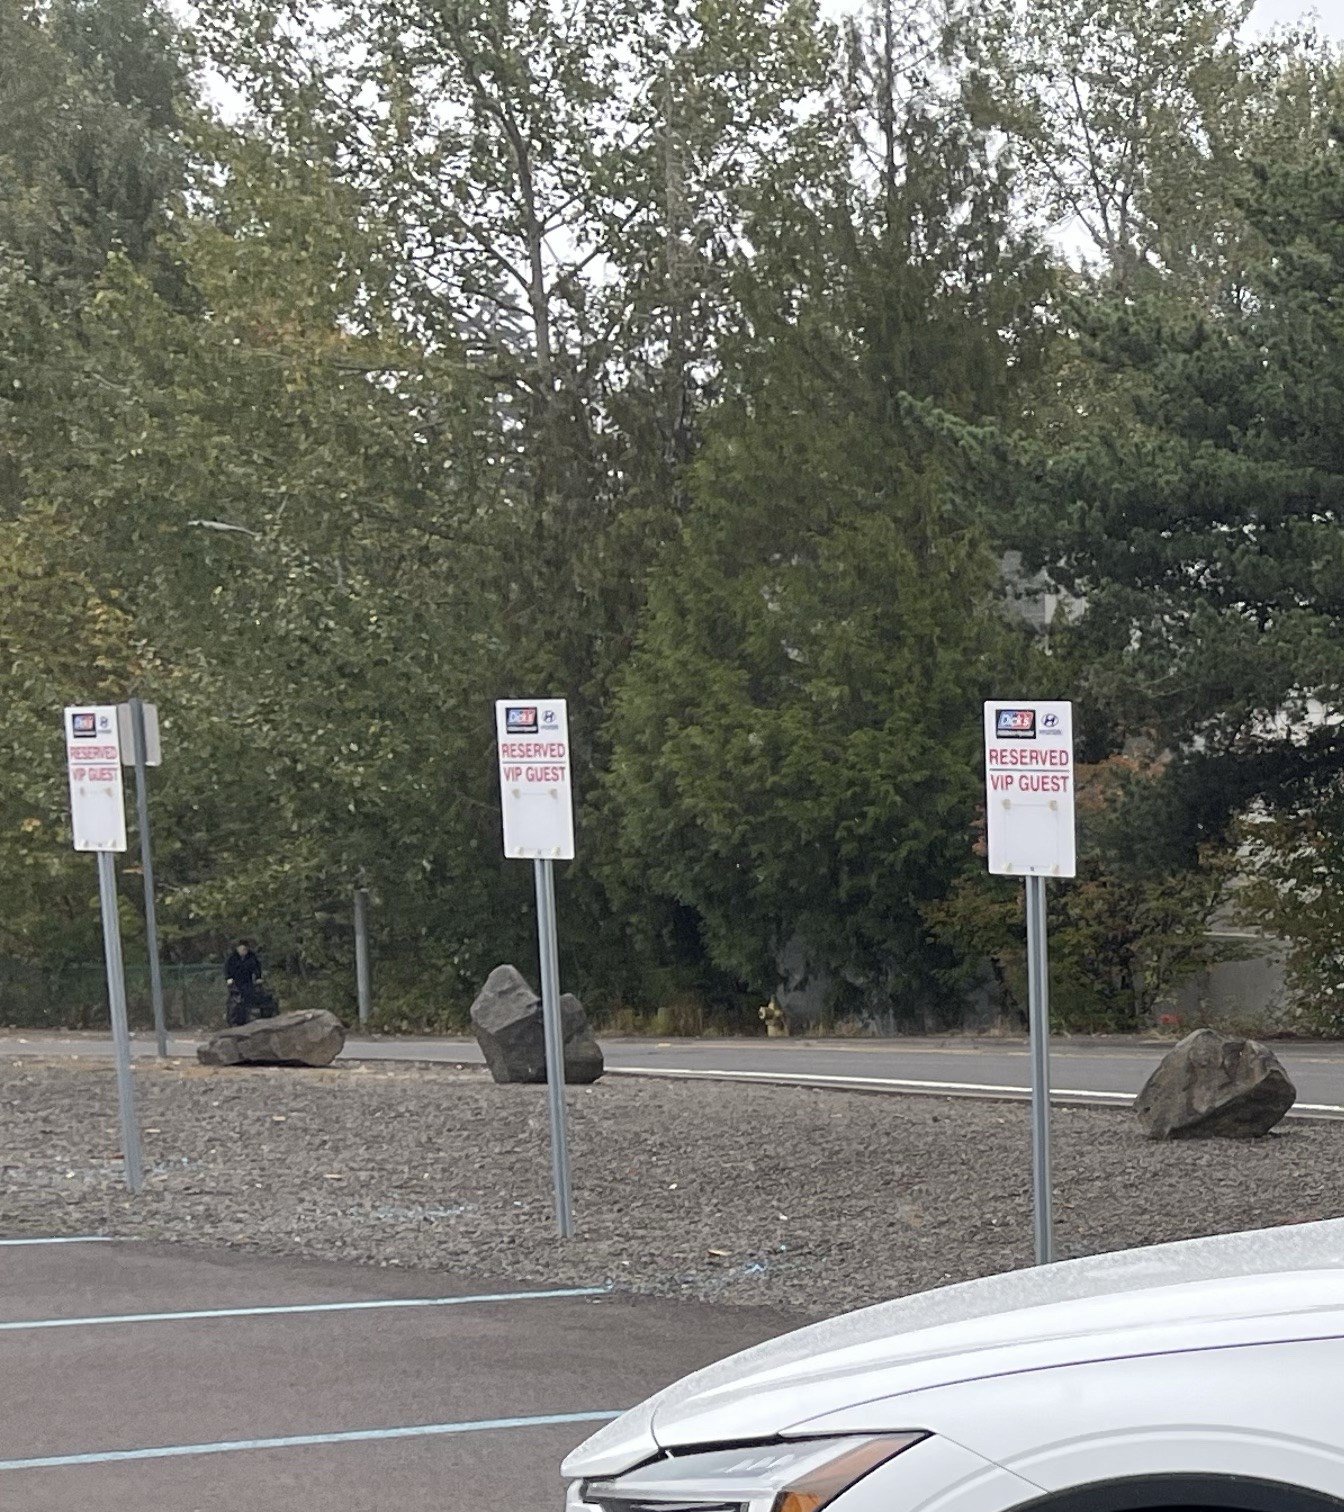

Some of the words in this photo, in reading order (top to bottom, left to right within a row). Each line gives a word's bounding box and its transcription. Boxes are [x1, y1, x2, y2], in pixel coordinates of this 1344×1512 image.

[502, 743, 566, 758] RESERVED
[989, 749, 1069, 766] RESERVED
[503, 766, 522, 781] VIP
[525, 766, 566, 782] GUEST
[990, 774, 1014, 791] VIP
[1019, 774, 1069, 792] GUEST
